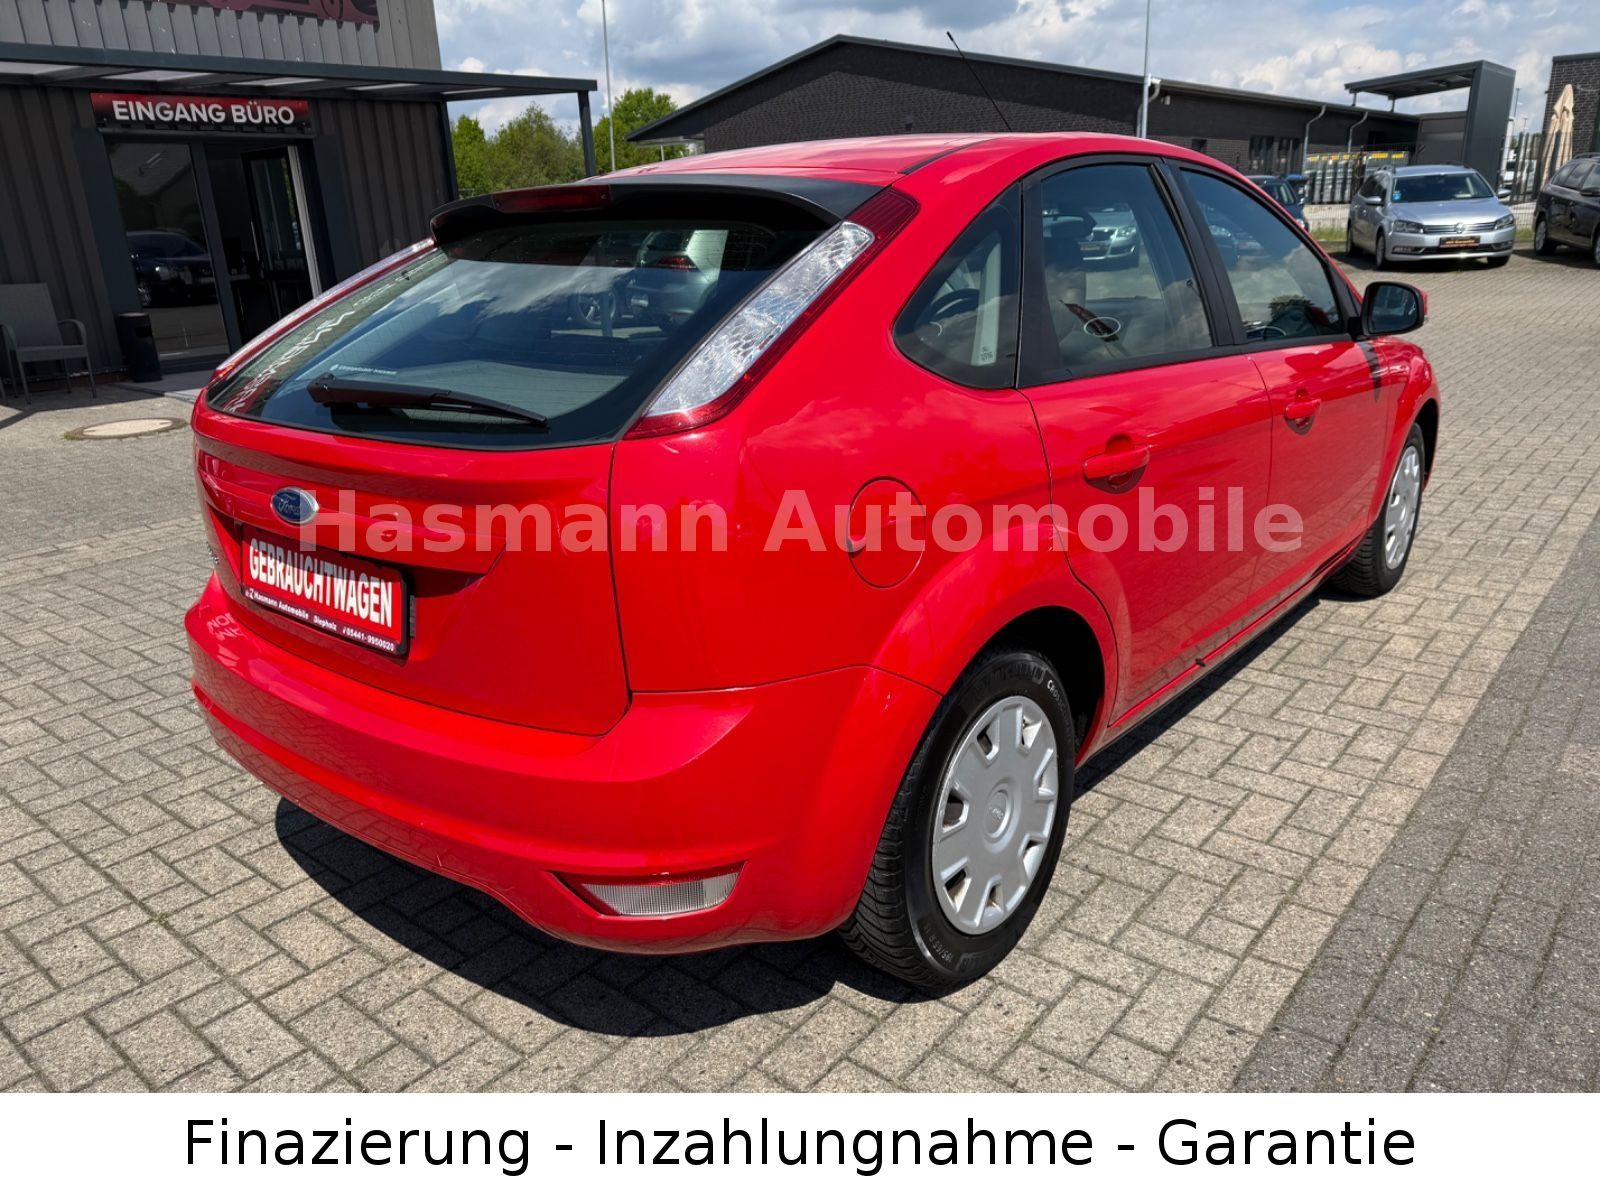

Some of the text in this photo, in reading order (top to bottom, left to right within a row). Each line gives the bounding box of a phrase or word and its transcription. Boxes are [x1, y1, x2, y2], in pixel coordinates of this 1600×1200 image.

[112, 100, 295, 125] EINGANG BÜRO
[249, 538, 392, 628] GEBRAUCHTWAGEN
[253, 591, 278, 607] Hasmann
[278, 601, 309, 620] Automobile
[313, 615, 337, 631] Diepholz
